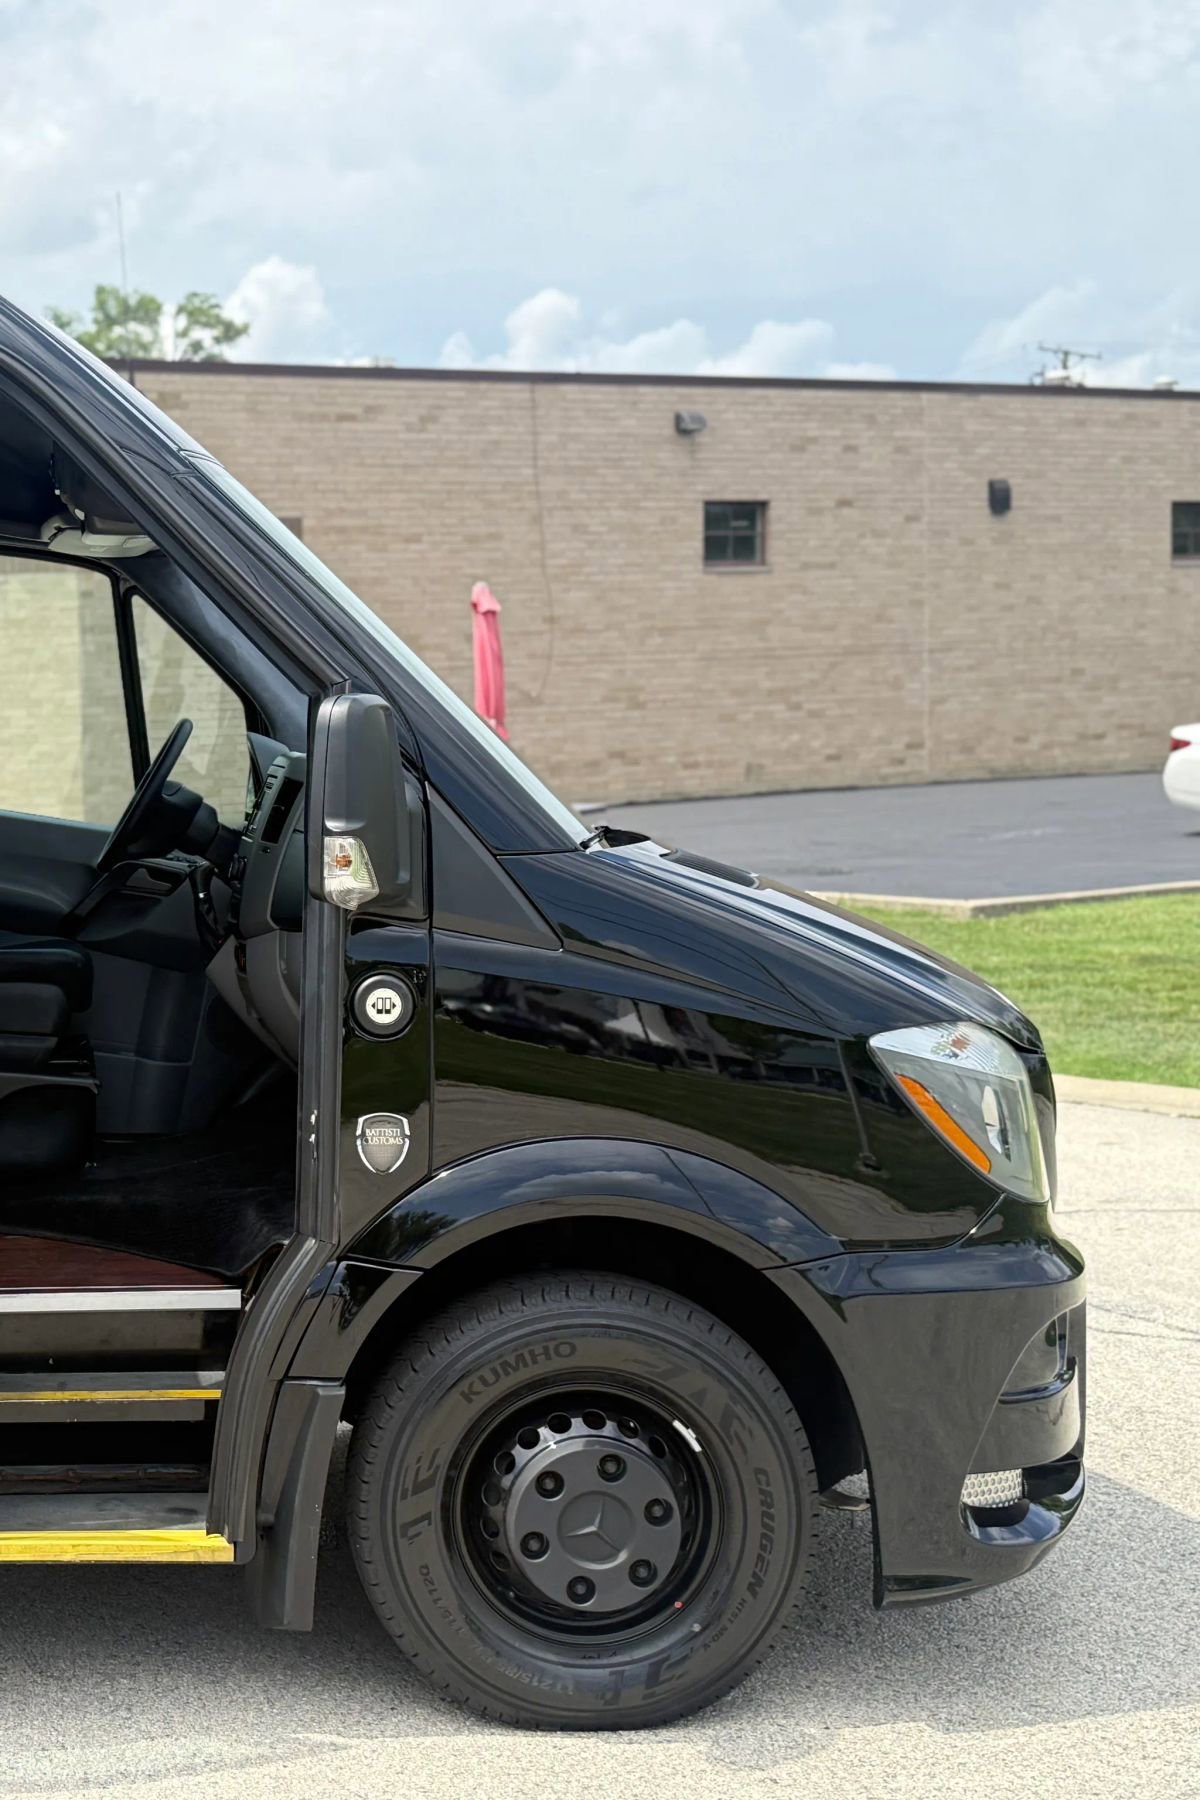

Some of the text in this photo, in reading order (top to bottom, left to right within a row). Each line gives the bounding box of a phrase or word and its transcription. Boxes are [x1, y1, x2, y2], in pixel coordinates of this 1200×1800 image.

[362, 1136, 404, 1145] CUSTOMS
[365, 1128, 401, 1137] BATTISTI
[459, 1341, 577, 1404] KUMHO
[747, 1467, 776, 1599] CRUGEN
